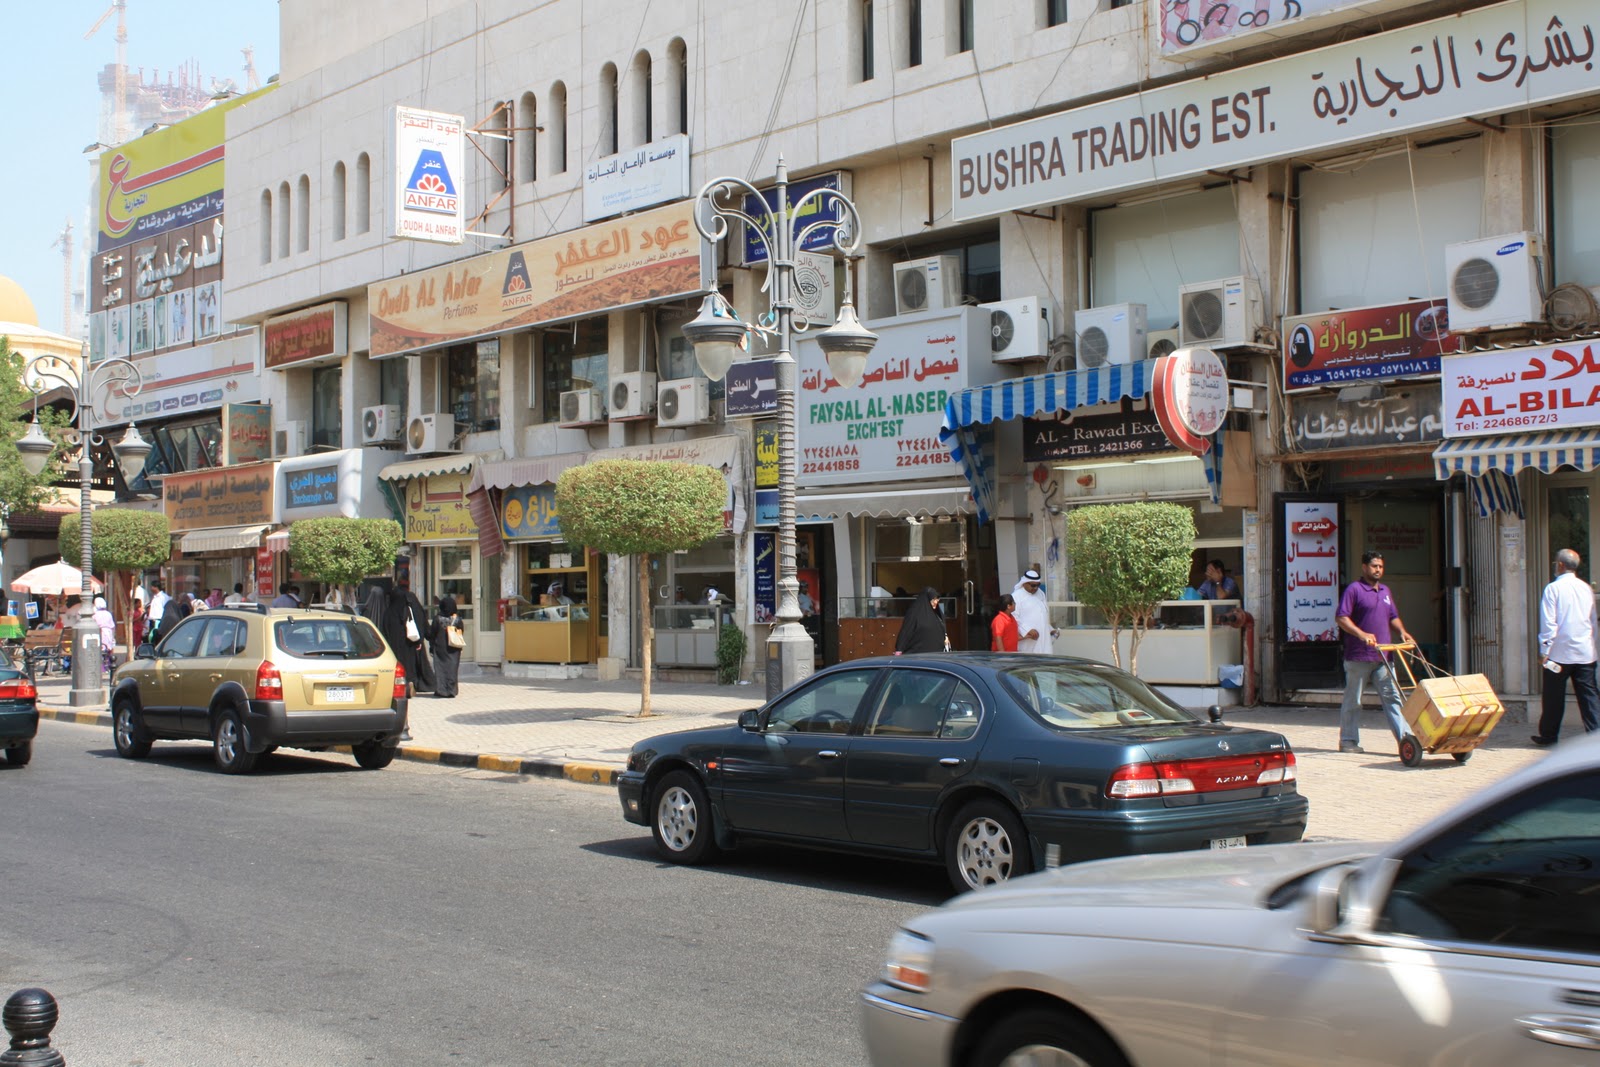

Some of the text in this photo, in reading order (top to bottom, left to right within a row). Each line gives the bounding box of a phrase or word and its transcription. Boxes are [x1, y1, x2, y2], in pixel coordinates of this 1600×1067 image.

[1312, 35, 1462, 127] التجارية
[959, 86, 1276, 199] BUSHRA TRADING EST.
[588, 159, 618, 184] التجارية
[406, 193, 457, 210] ANFAR
[403, 220, 457, 236] OUDH AL ANFAR
[640, 219, 689, 250] عود
[555, 268, 594, 292] للعطور
[377, 285, 410, 318] Oudh
[443, 269, 482, 302] Anfar
[502, 294, 533, 308] ANFAR
[443, 303, 479, 320] Perfumes
[927, 334, 956, 344] مؤسسة
[1319, 312, 1411, 352] الدروازة
[858, 356, 910, 388] الناصر
[913, 349, 959, 382] فيصل
[1457, 372, 1516, 390] للصيرفة
[810, 399, 863, 425] FAYSAL
[1455, 413, 1558, 431] Tel: 22468672/3
[1035, 430, 1058, 444] AL
[1074, 423, 1126, 440] Rawad
[803, 444, 859, 459] ٢٢٤٤١٨٥٨
[897, 437, 948, 452] ٢٢٤٤١٨
[1069, 445, 1091, 455] TEL
[1100, 440, 1143, 452] 2421366
[803, 459, 860, 473] 22441858
[896, 452, 951, 467] 2244185
[324, 490, 335, 500] Co.
[408, 514, 437, 536] Royal
[1312, 522, 1330, 531] الطابق
[1287, 540, 1336, 563] عقال
[1287, 570, 1337, 592] السلطان
[1294, 598, 1311, 608] عقال
